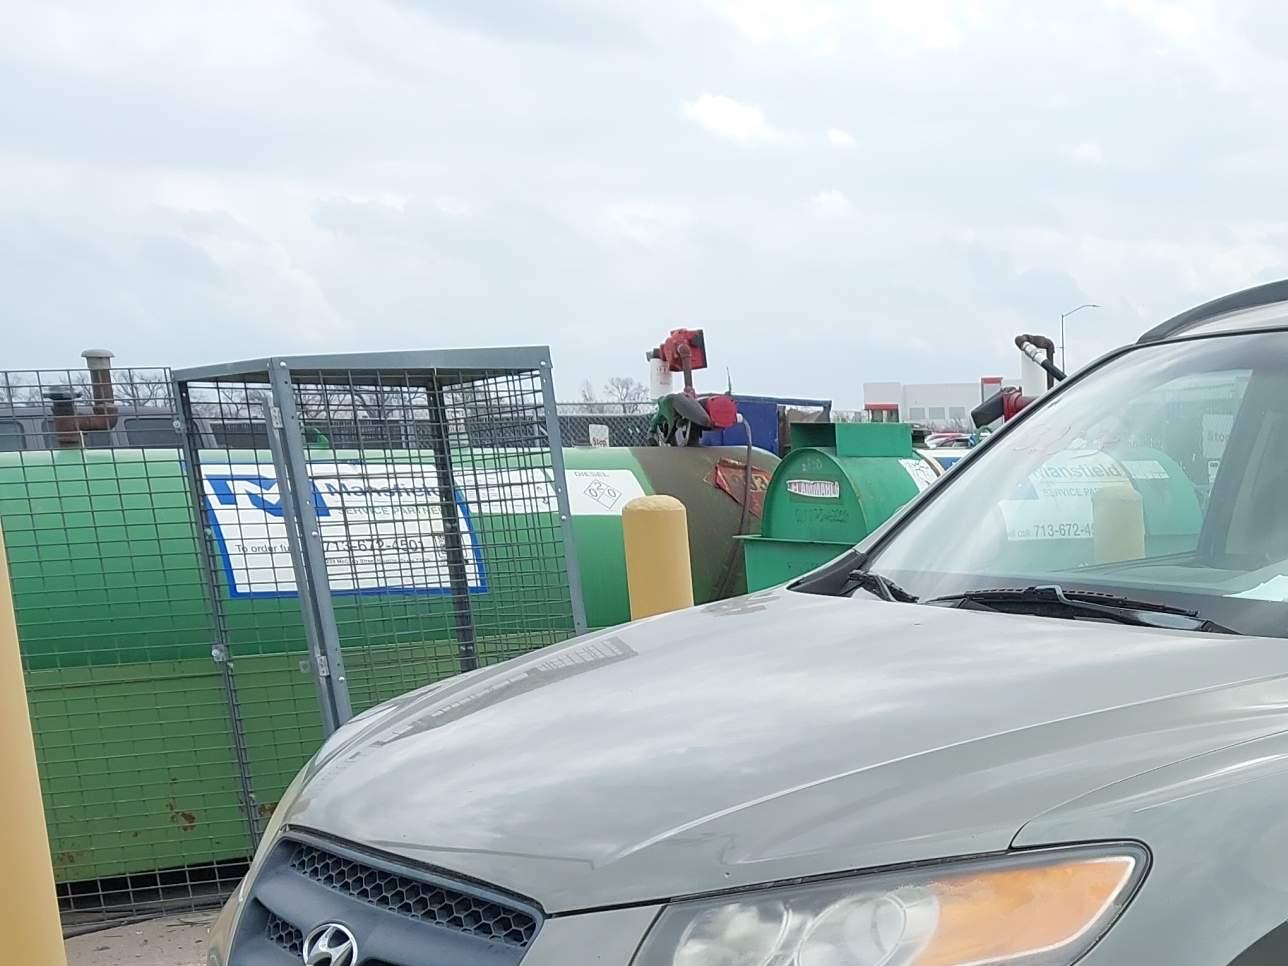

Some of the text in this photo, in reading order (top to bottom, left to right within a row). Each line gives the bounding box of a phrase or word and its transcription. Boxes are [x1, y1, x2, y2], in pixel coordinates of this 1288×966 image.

[393, 505, 442, 516] PARTNE
[234, 543, 248, 553] To
[250, 543, 277, 553] order
